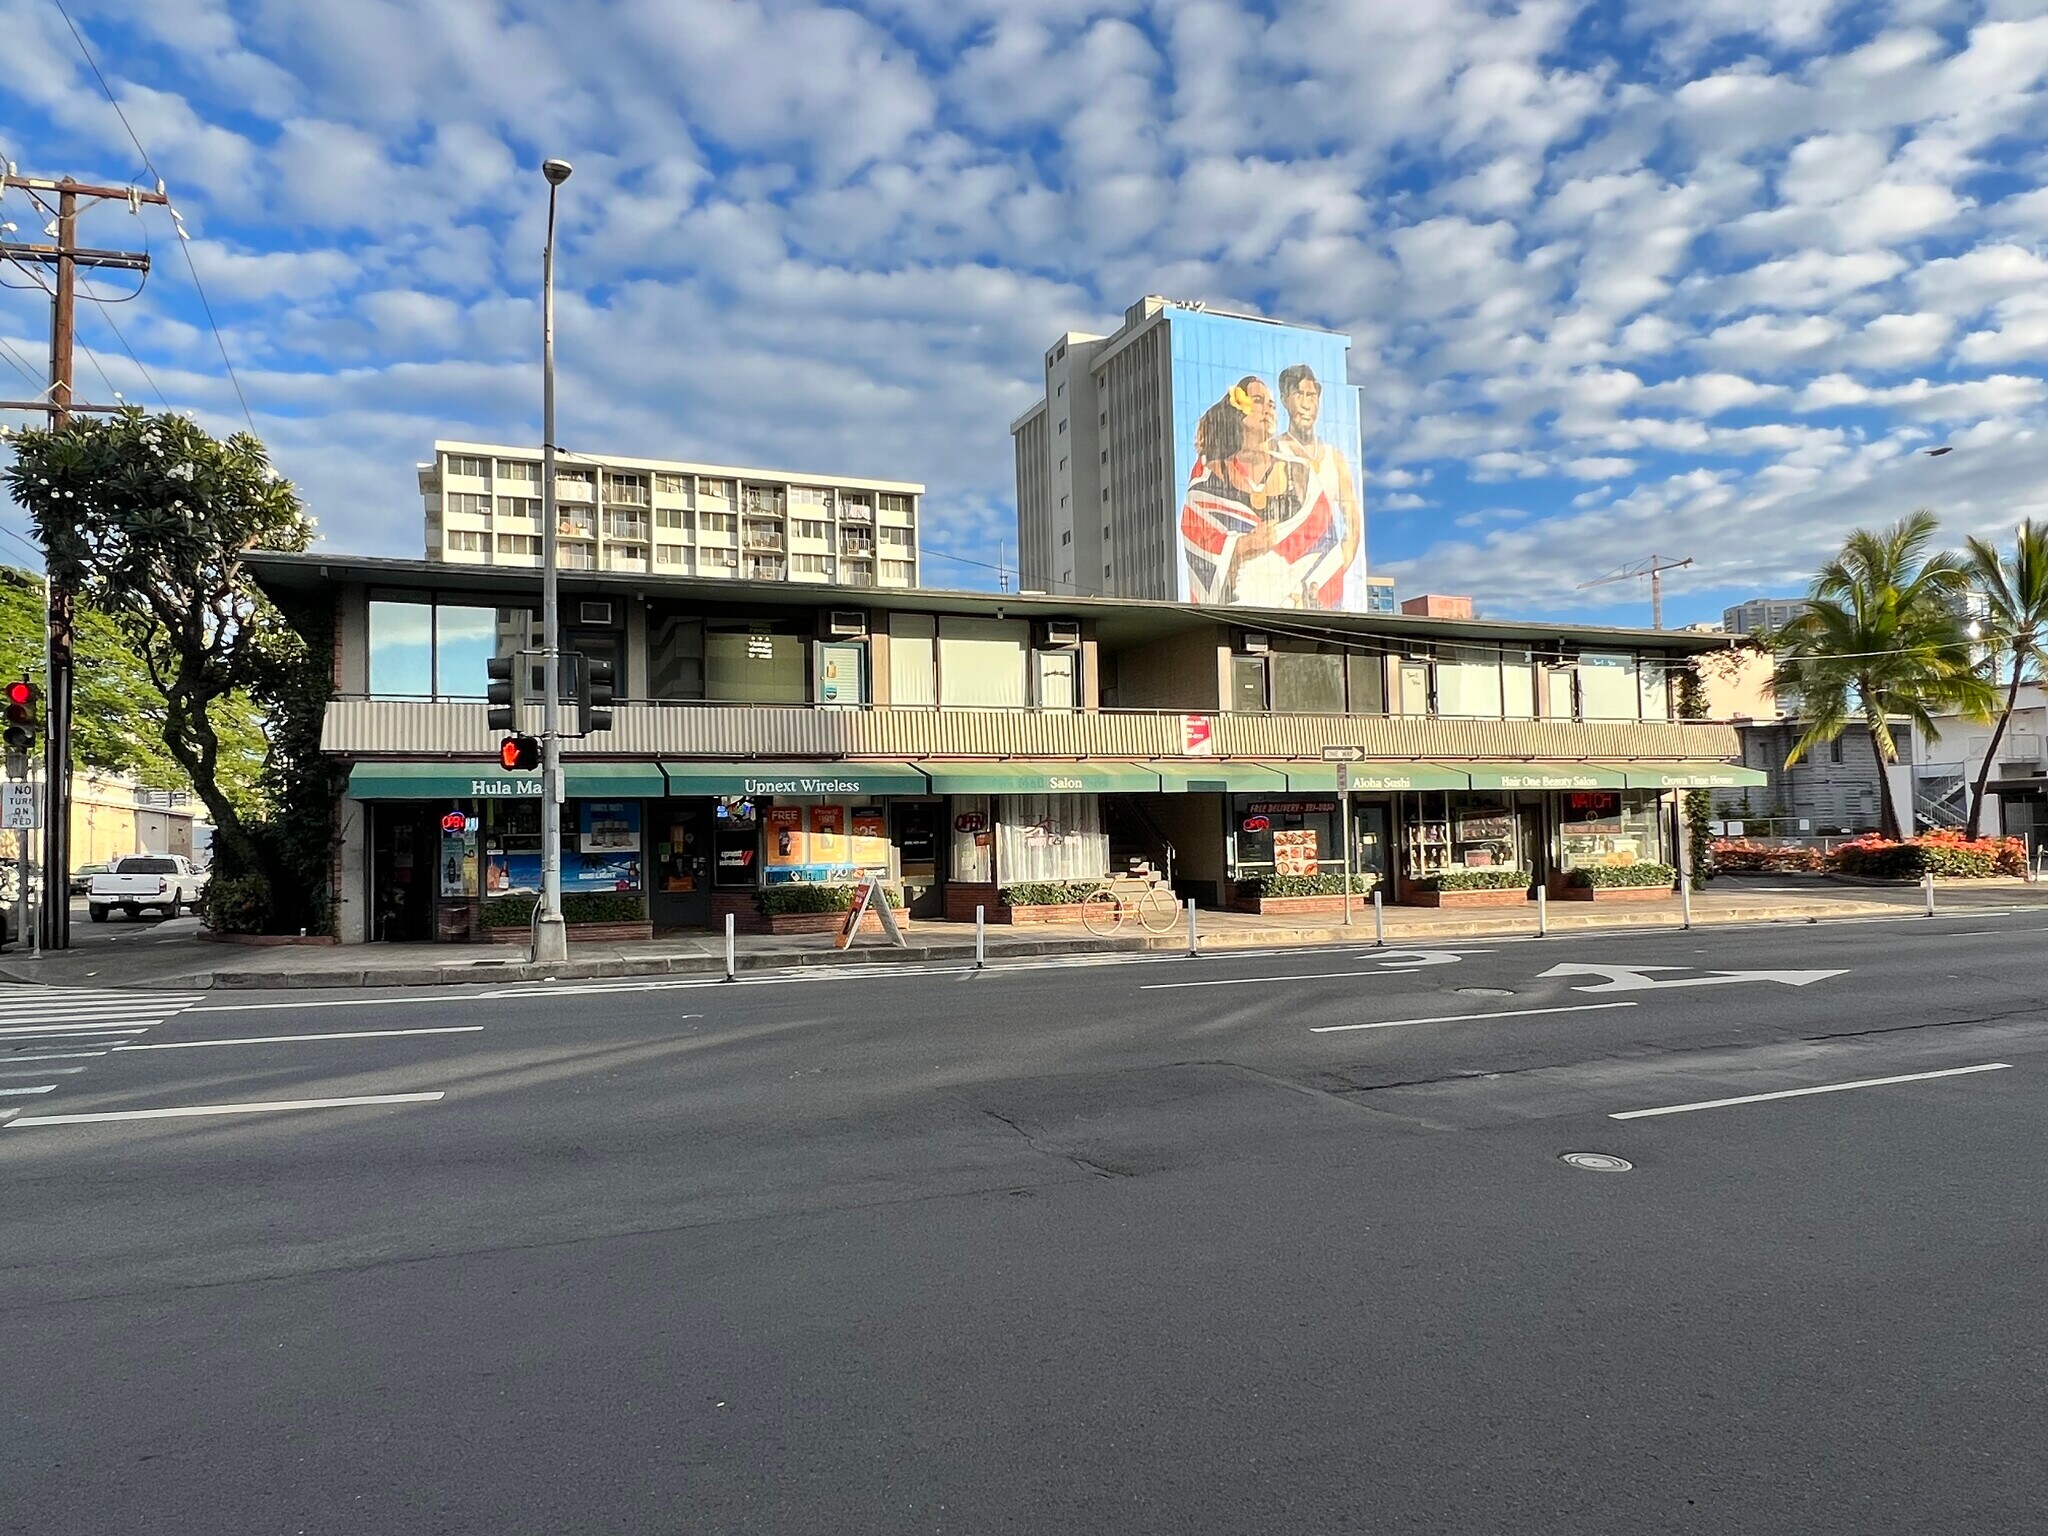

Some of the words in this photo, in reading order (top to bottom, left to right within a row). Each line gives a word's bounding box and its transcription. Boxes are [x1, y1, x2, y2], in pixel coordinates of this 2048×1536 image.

[1049, 776, 1083, 789] Salon
[1353, 777, 1382, 789] Aloha
[1383, 777, 1411, 789] Sushi
[1501, 776, 1521, 787] Hair
[1522, 776, 1540, 787] One
[1542, 776, 1572, 788] Beauty
[1573, 776, 1598, 787] Salon
[1661, 776, 1688, 786] Crown
[1689, 776, 1709, 785] Time
[1710, 776, 1734, 785] House
[15, 786, 31, 794] NO
[471, 780, 512, 795] Hula
[516, 780, 543, 795] Ma
[744, 779, 797, 796] Upnext
[800, 779, 860, 793] Wireless
[15, 807, 29, 815] ON
[771, 810, 798, 820] FREE
